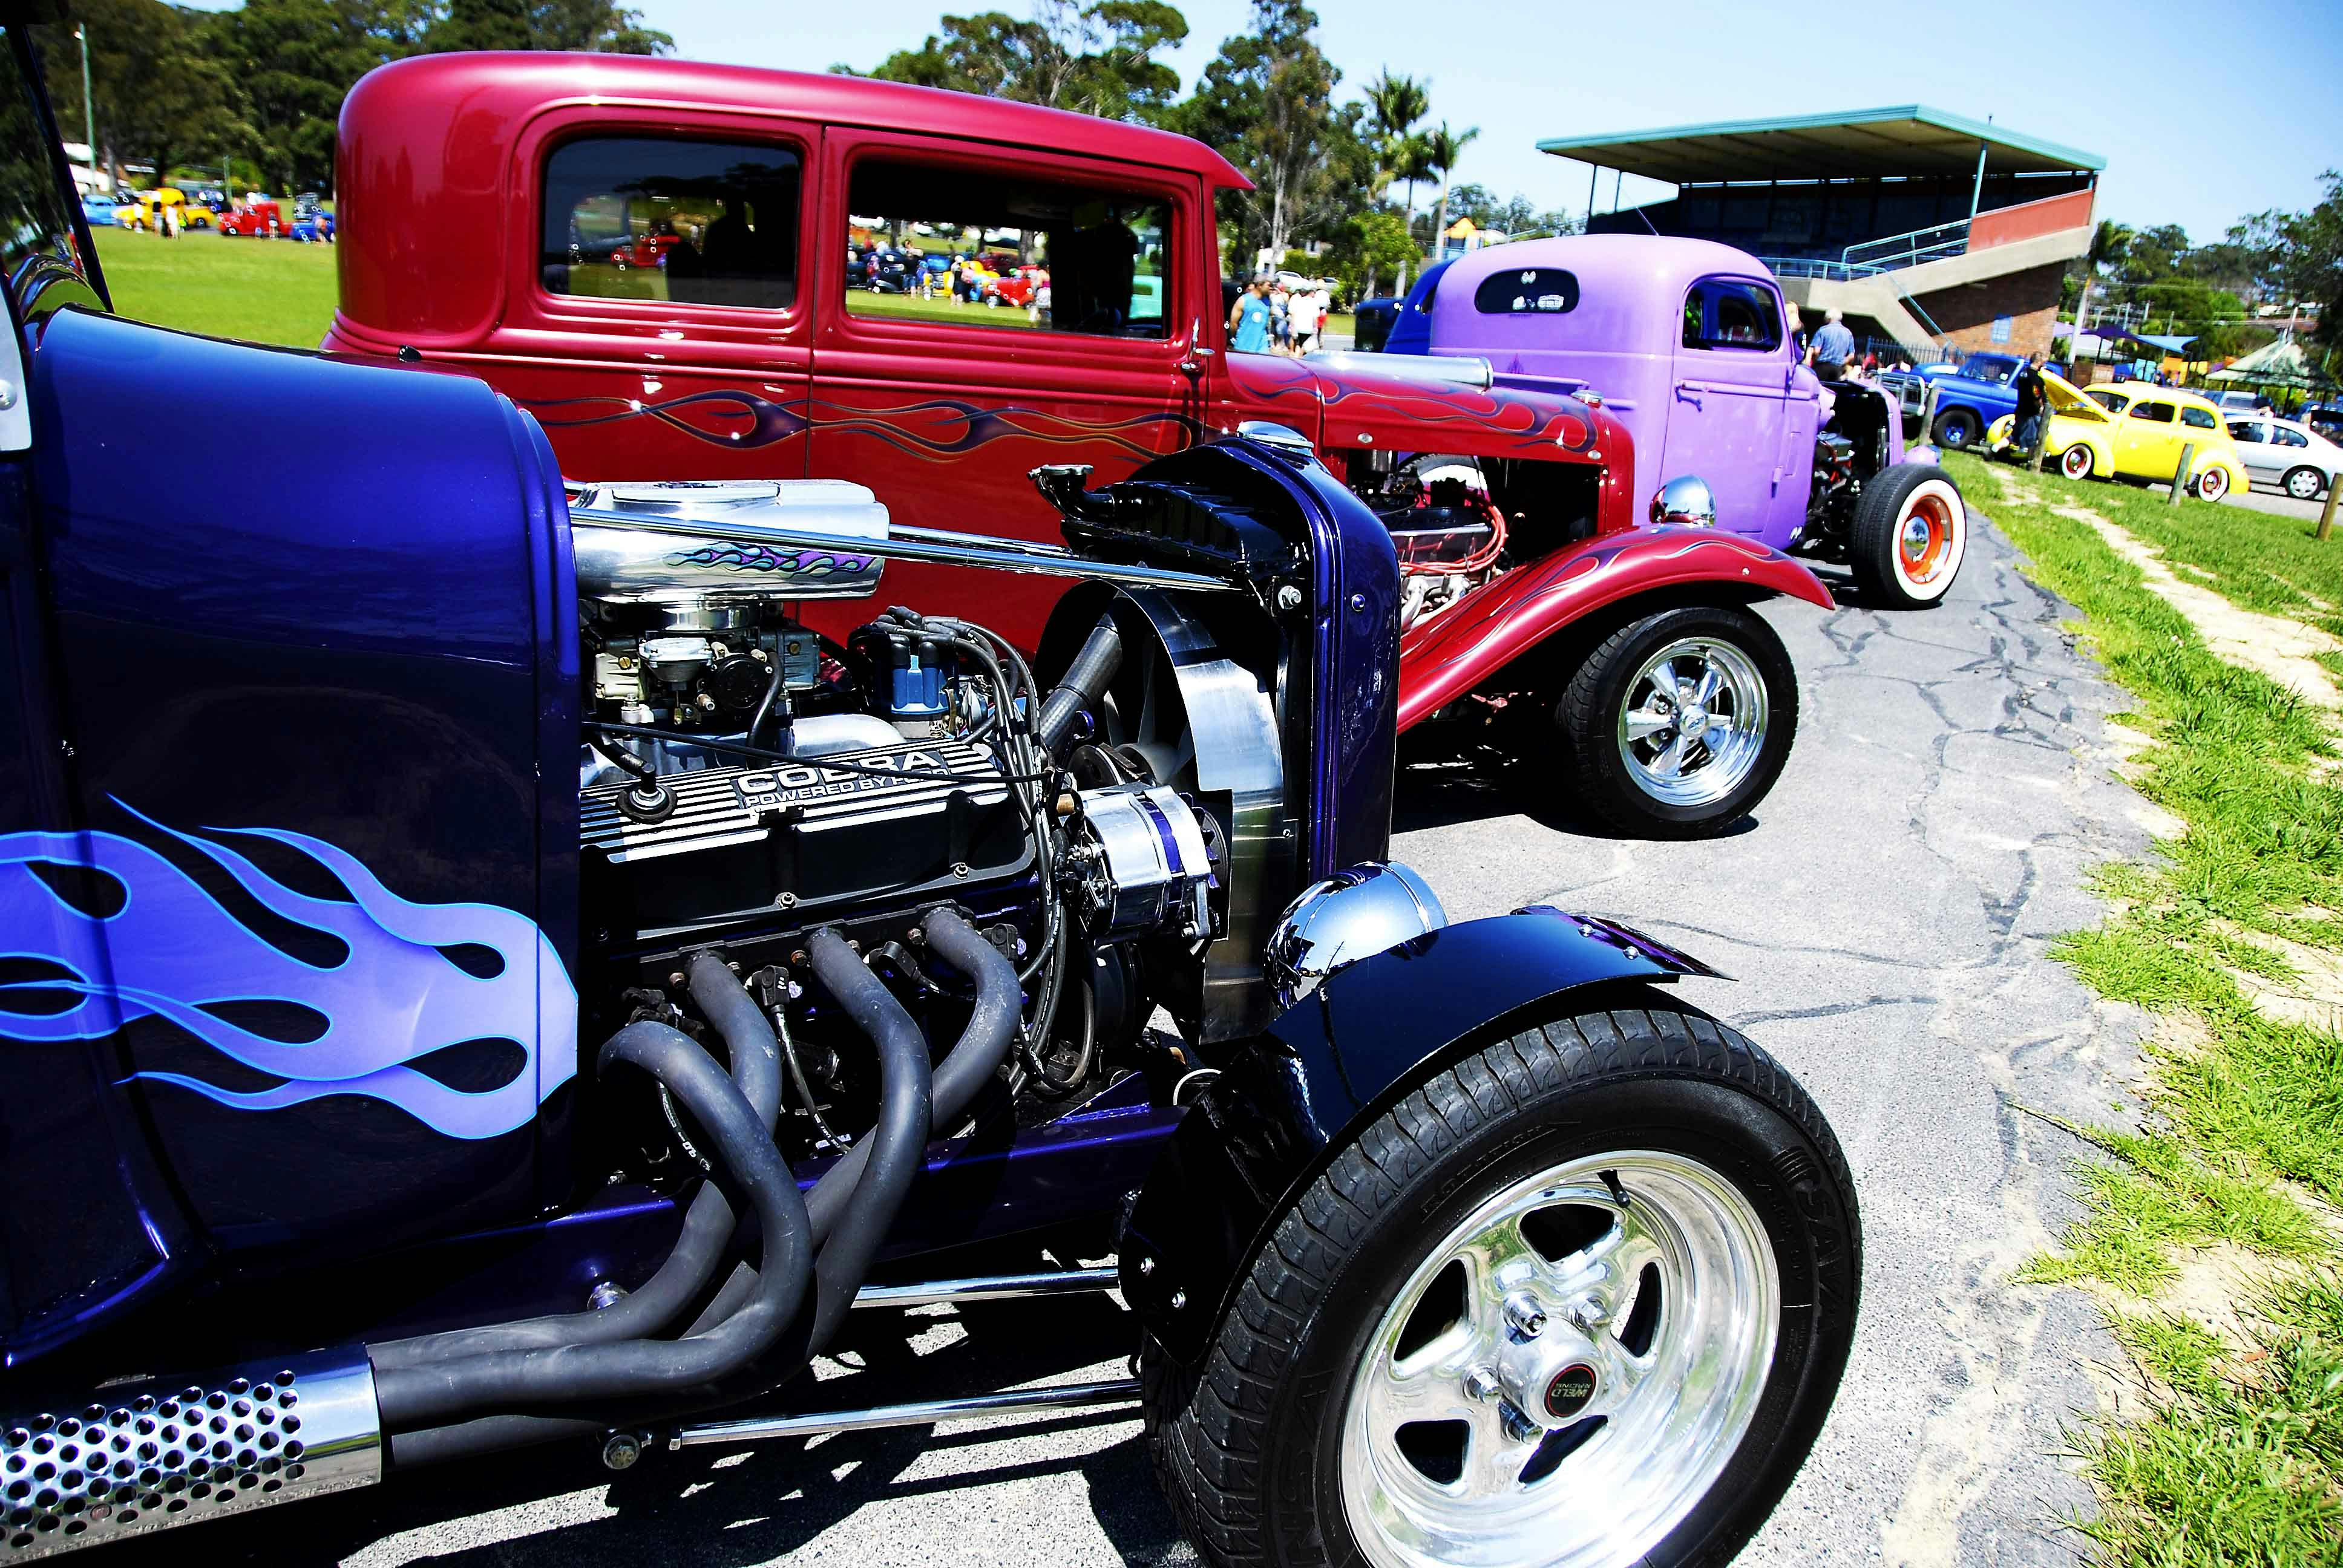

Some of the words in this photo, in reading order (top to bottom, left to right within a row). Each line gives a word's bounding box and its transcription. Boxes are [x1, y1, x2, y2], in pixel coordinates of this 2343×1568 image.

[738, 752, 942, 793] COBRA
[744, 782, 855, 808] POWERED
[859, 776, 887, 790] BY
